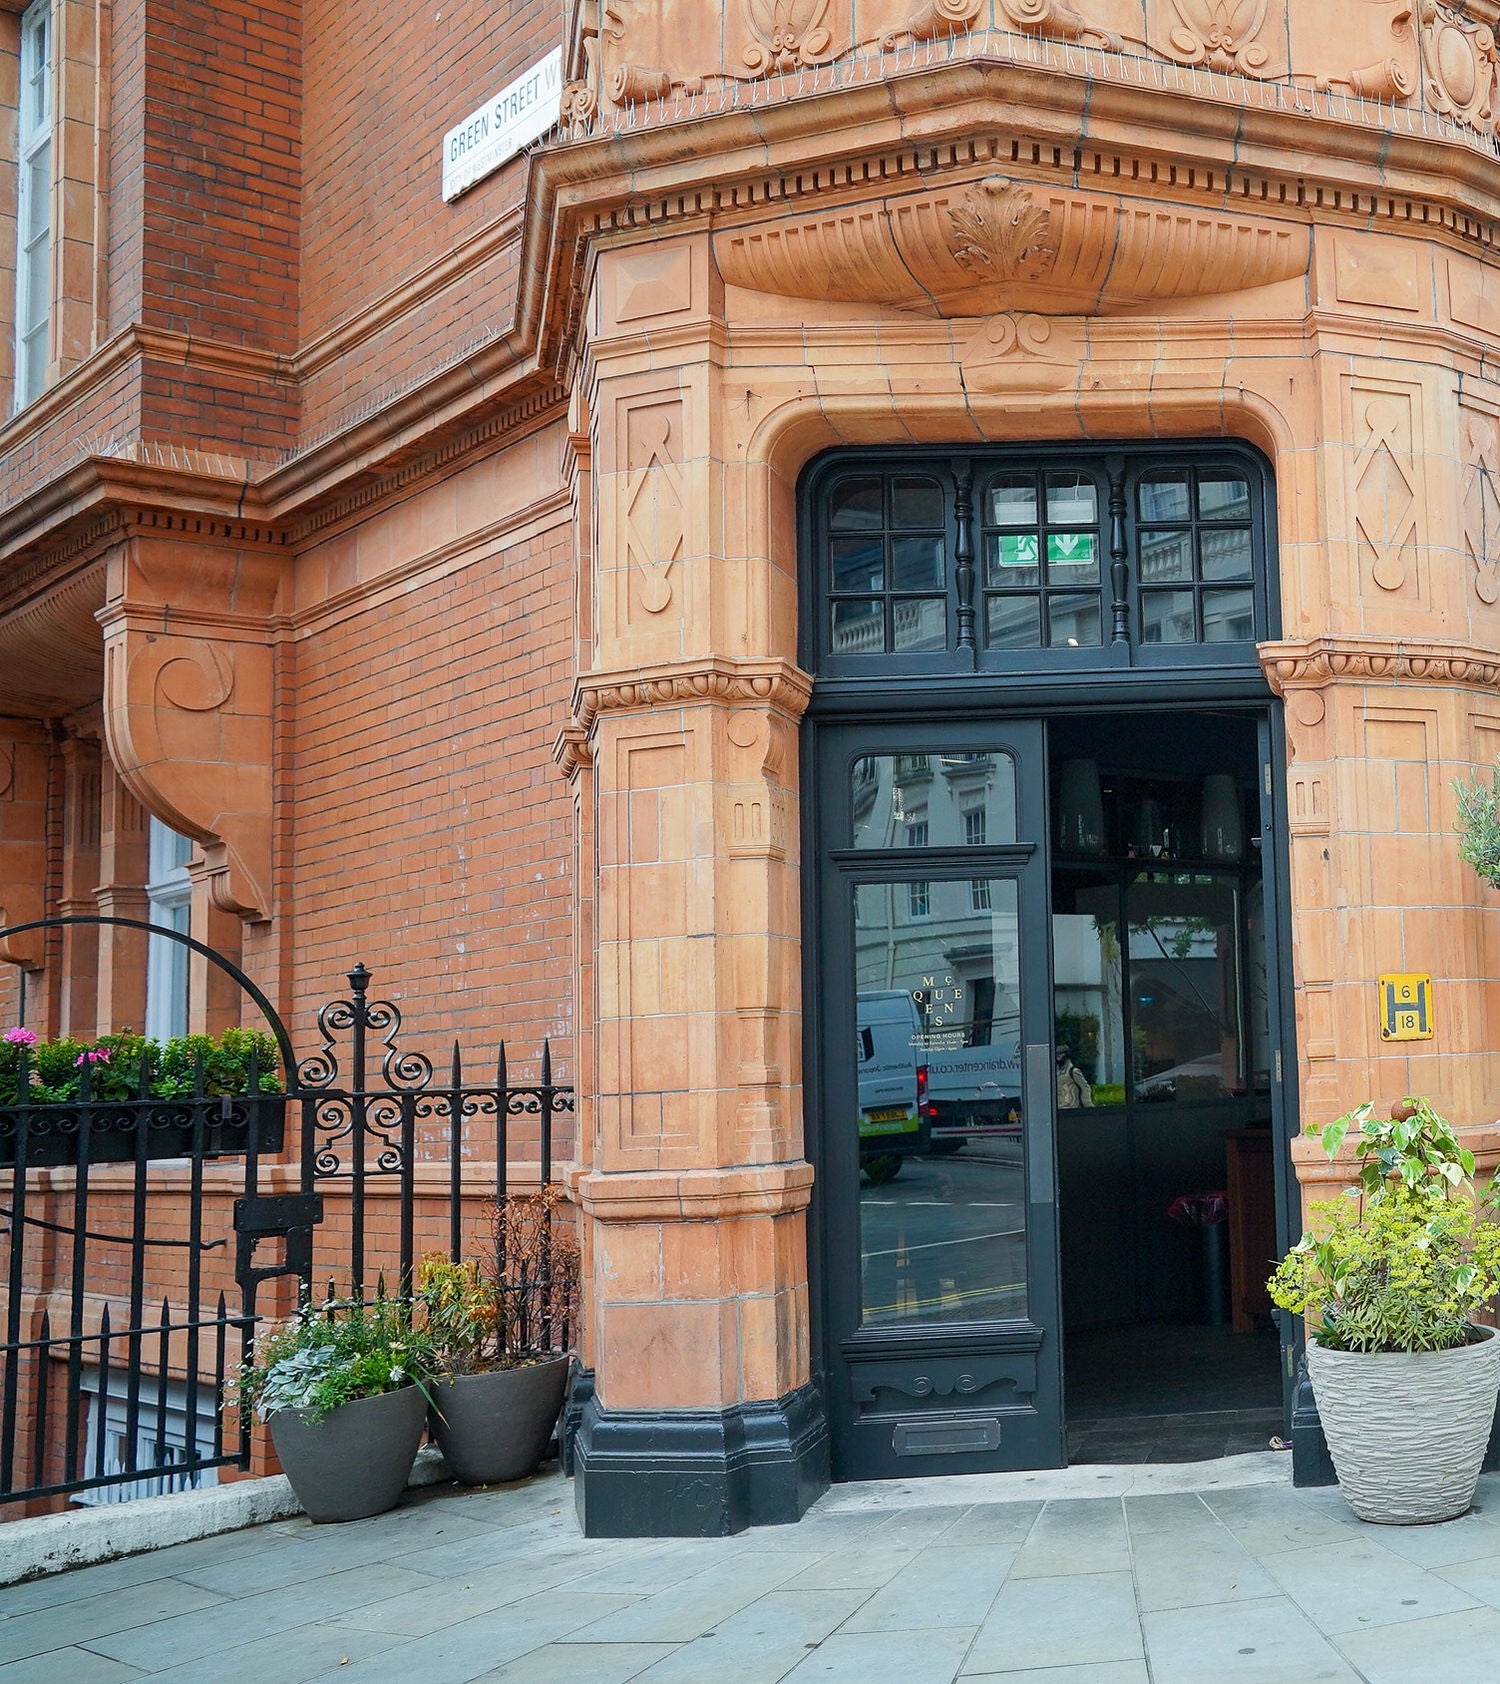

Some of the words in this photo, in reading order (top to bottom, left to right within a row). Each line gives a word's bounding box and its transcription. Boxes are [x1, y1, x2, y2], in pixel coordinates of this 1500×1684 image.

[450, 112, 489, 162] GREEN
[494, 73, 540, 129] STREET
[1401, 985, 1411, 998] 6
[1386, 981, 1427, 1034] H
[1401, 1015, 1415, 1029] 18
[911, 1033, 941, 1041] OPENING
